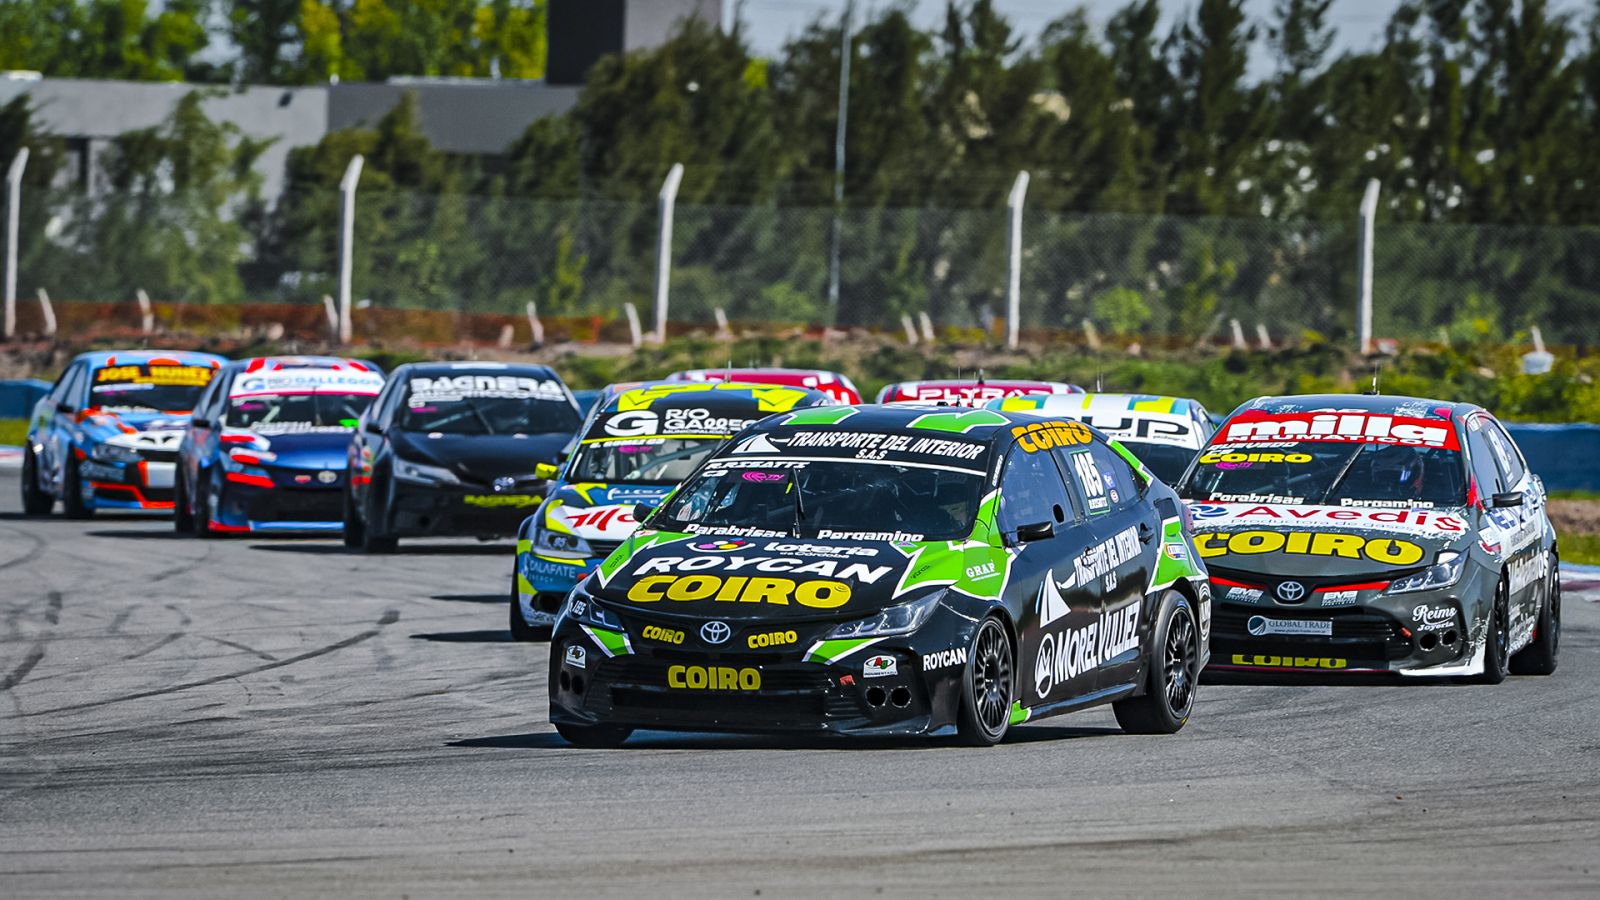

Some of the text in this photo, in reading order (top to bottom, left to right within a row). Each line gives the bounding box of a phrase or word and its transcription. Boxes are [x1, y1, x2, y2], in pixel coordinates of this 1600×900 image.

[787, 431, 986, 460] TRANSPORTE DEL INTERIOR
[1011, 421, 1092, 453] COIRO
[1200, 453, 1312, 463] COIRO
[1072, 452, 1104, 497] 185
[1209, 492, 1434, 509] Parabrisas Pergamino
[1235, 506, 1462, 531] Avedis
[682, 524, 787, 538] Parabrisas
[1194, 531, 1424, 565] COIRO
[633, 556, 893, 584] ROYCAN
[627, 575, 852, 609] COIRO
[1268, 620, 1331, 629] GLOBAL TRADE
[1412, 604, 1457, 624] Reims
[642, 625, 685, 645] COIRO
[747, 630, 798, 649] COIRO
[923, 647, 967, 671] ROYCAN
[1232, 654, 1347, 668] COIRO
[668, 665, 761, 691] COIRO
